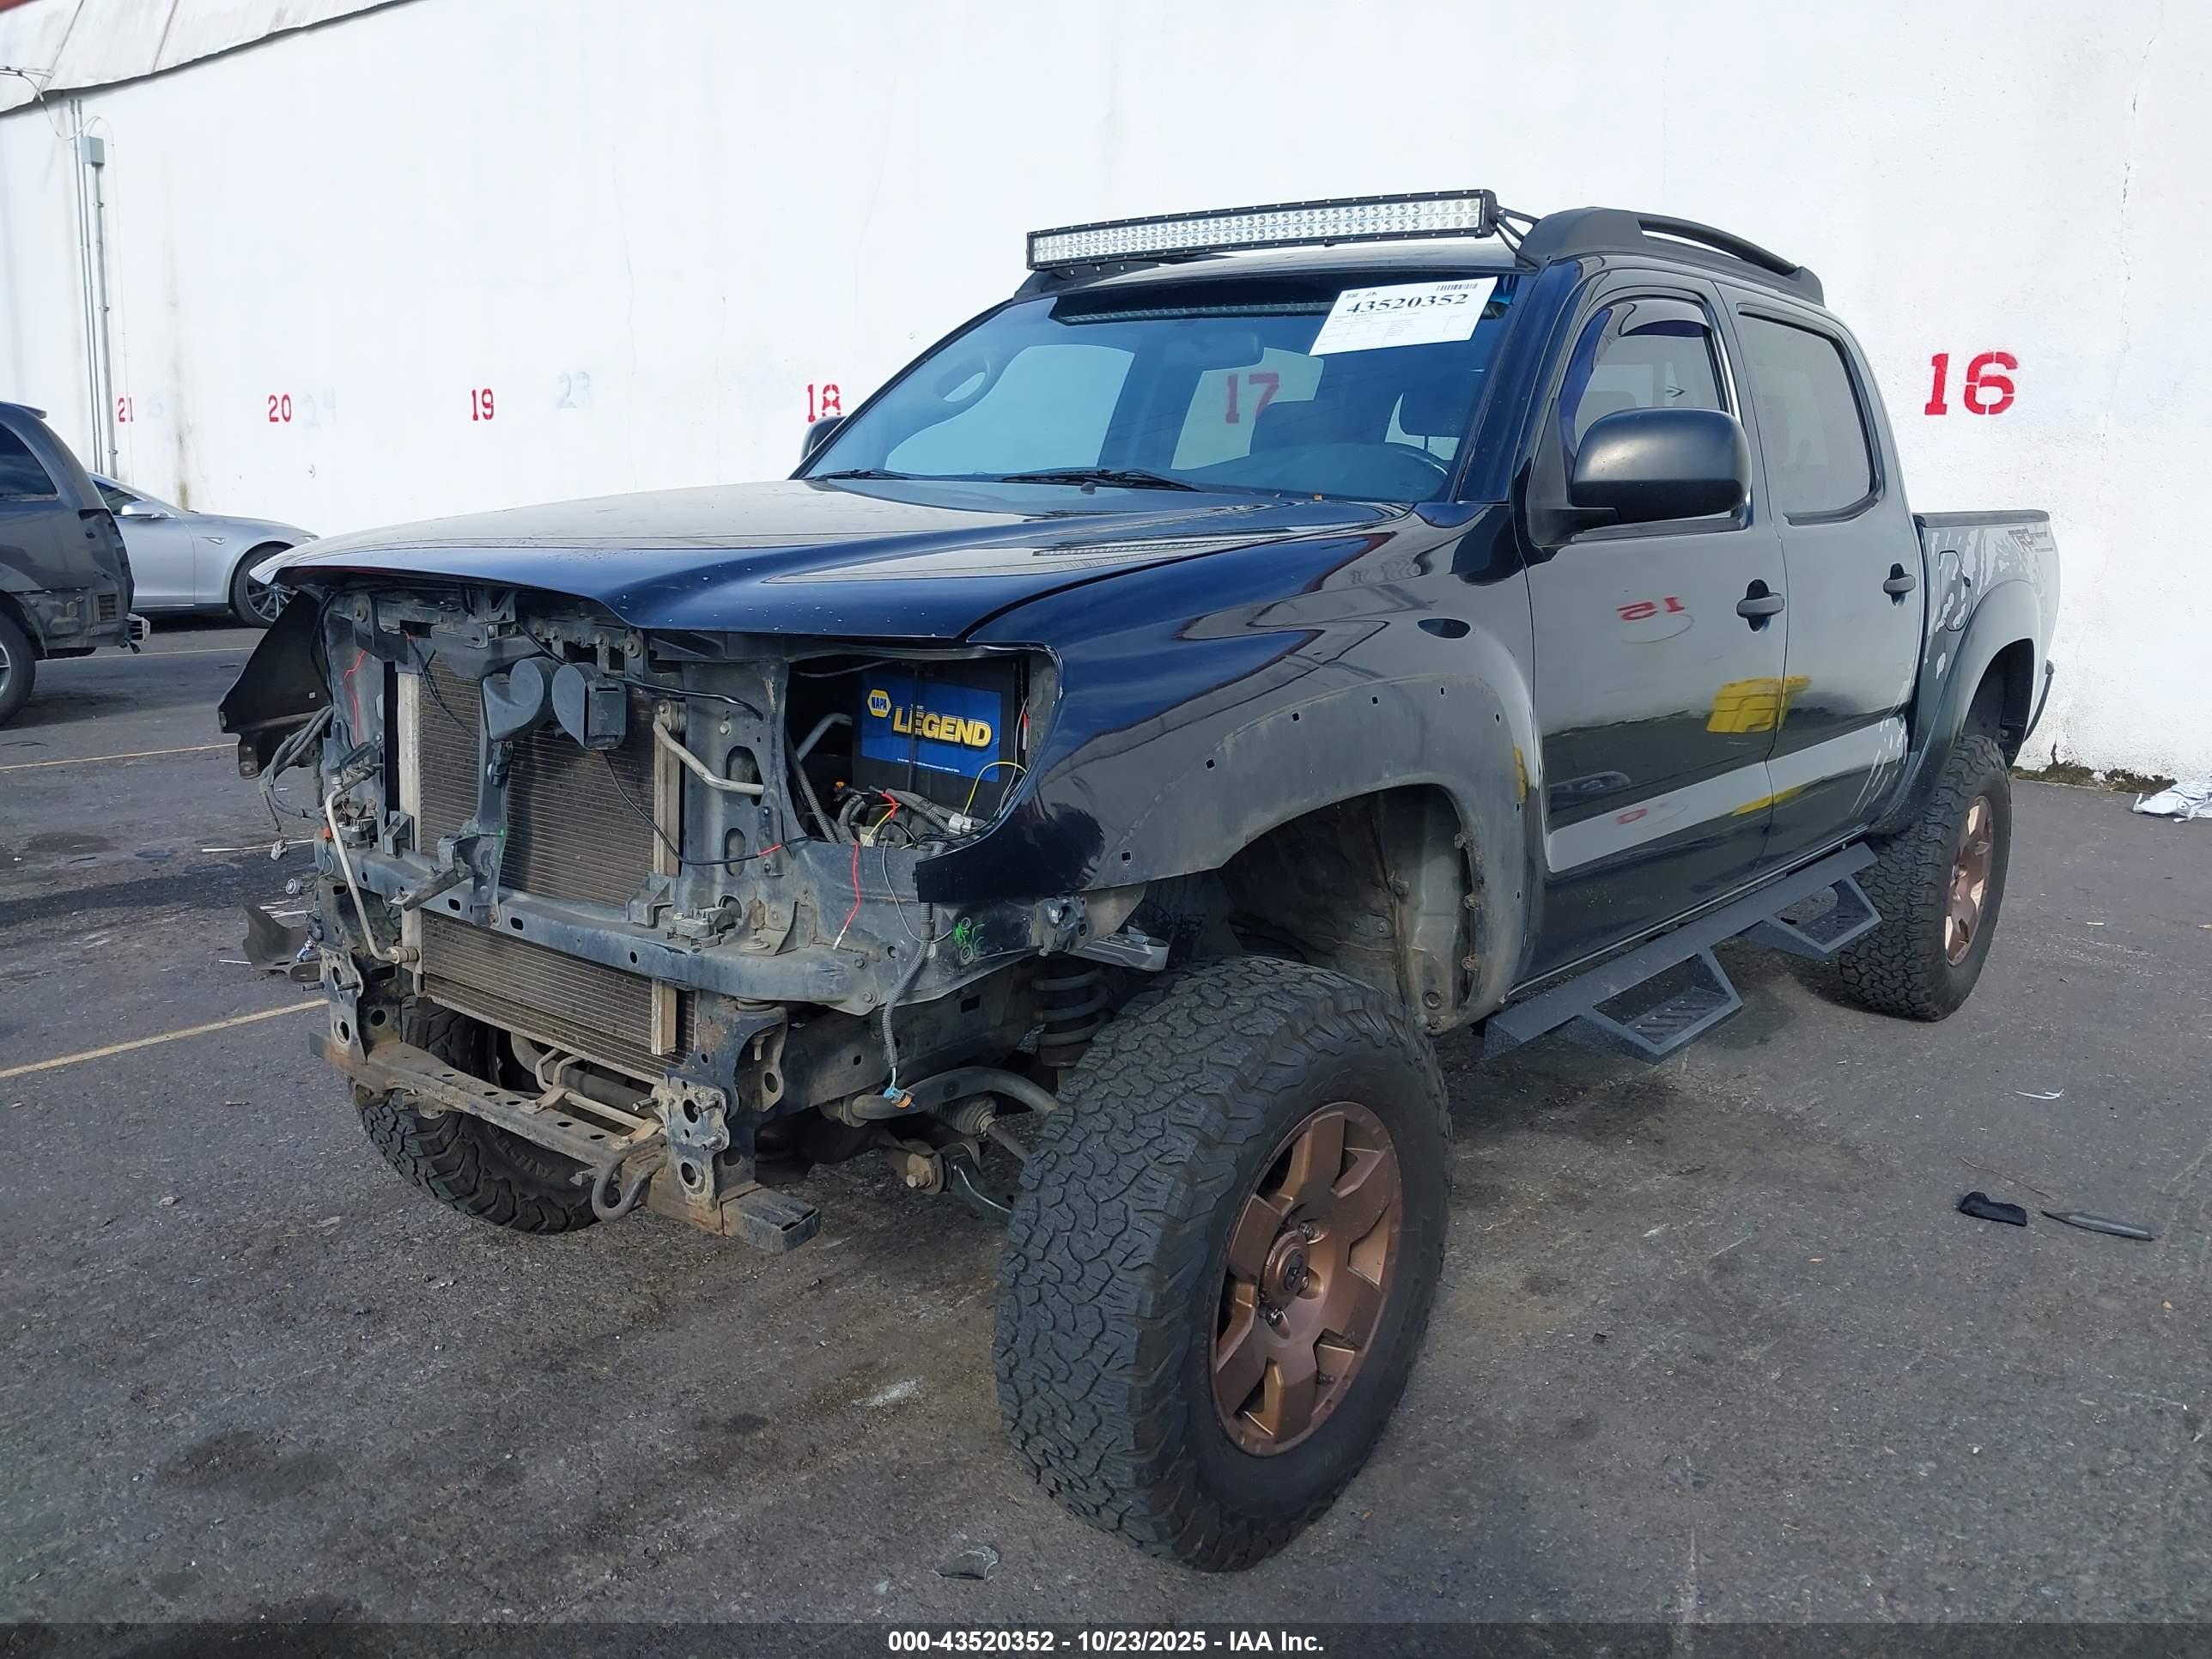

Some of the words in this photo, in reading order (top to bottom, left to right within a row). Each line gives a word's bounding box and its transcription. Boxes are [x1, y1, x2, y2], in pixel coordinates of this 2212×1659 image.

[1346, 294, 1468, 313] 43520352
[1226, 373, 1279, 423] 17
[1924, 351, 2019, 416] 16
[118, 398, 134, 422] 21
[268, 394, 292, 422] 20
[471, 388, 494, 421] 19
[808, 384, 841, 422] 18
[872, 696, 887, 711] NAPA
[893, 706, 993, 747] LEGEND
